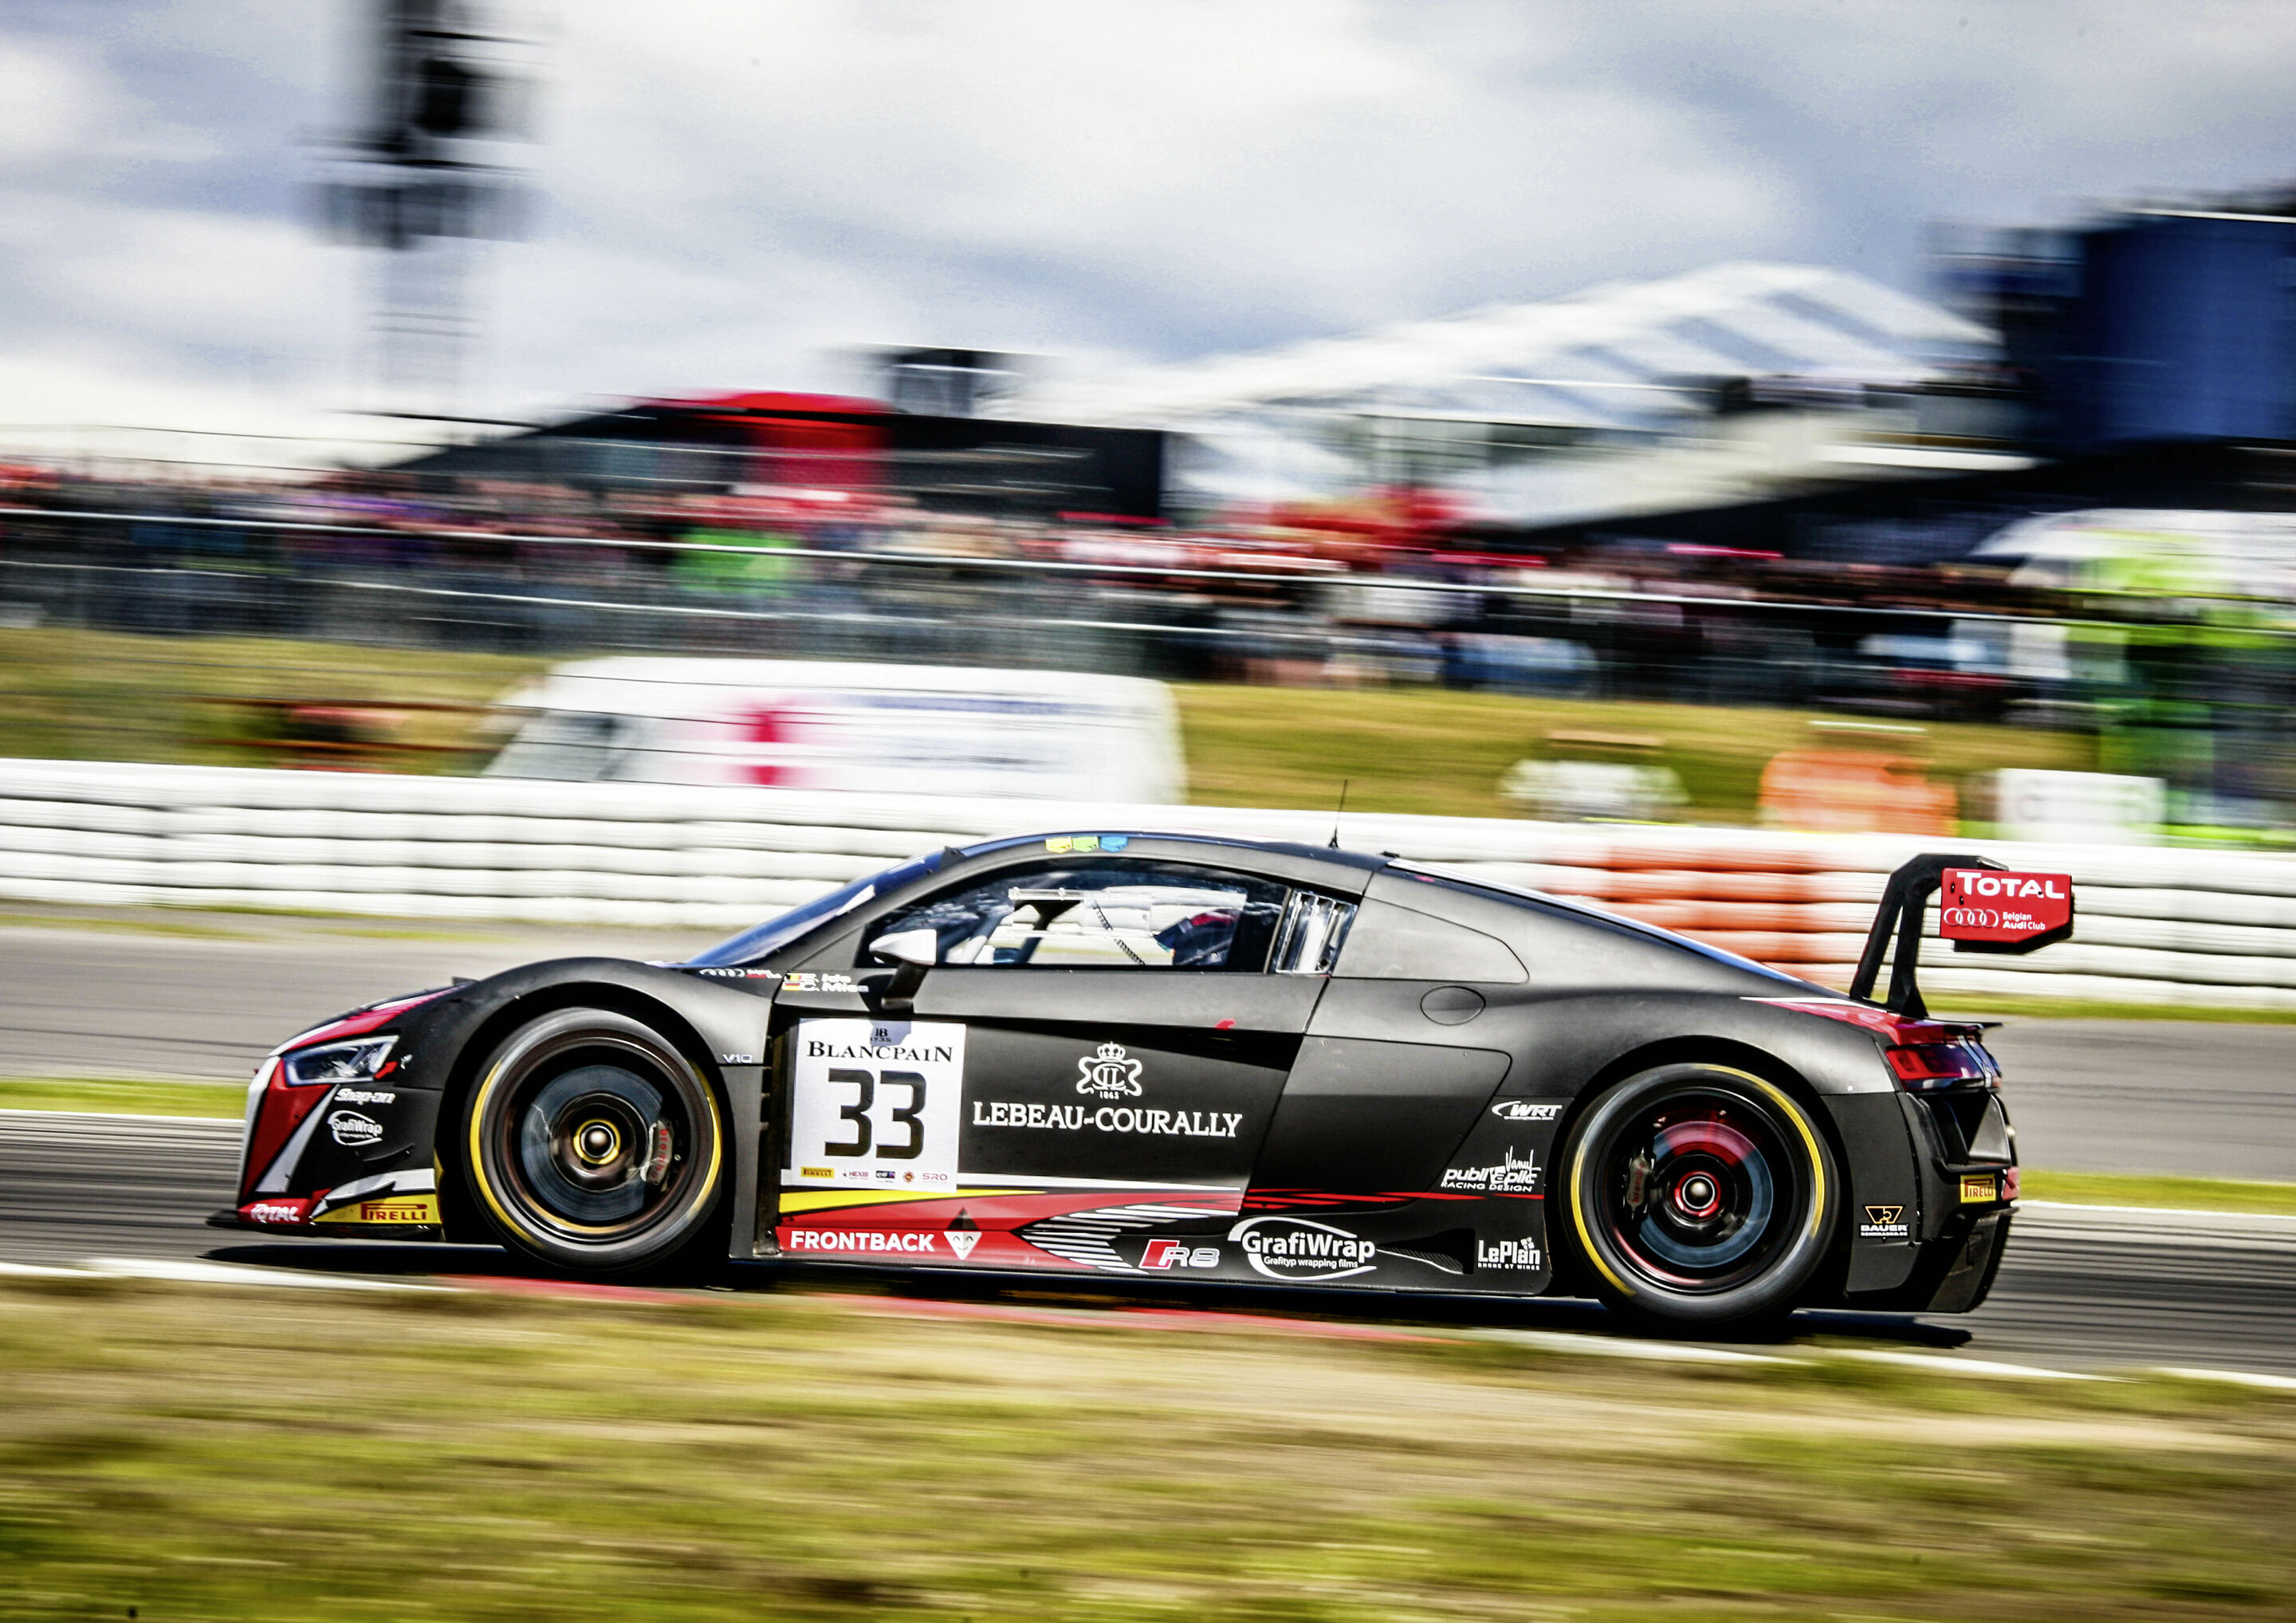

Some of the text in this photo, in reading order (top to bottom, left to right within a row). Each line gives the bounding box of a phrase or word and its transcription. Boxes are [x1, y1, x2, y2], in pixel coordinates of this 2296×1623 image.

[1956, 871, 2065, 899] TOTAL
[2003, 912, 2031, 922] Belgian
[2003, 921, 2027, 929] Audi
[722, 1054, 753, 1064] V10
[824, 1067, 926, 1159] 33
[1509, 1104, 1563, 1117] WRT
[973, 1101, 1243, 1138] LEBEAU-COURALLY
[922, 1173, 948, 1181] SRO
[1441, 1181, 1533, 1193] RACING DESIGN
[1964, 1177, 1994, 1198] PIRELLI
[250, 1203, 300, 1222] TOTAL
[360, 1203, 428, 1220] PIRELLI
[790, 1230, 935, 1252] FRONTBACK
[1241, 1231, 1376, 1263] GrafiWrap
[1264, 1256, 1358, 1270] Grafityp wrapping films
